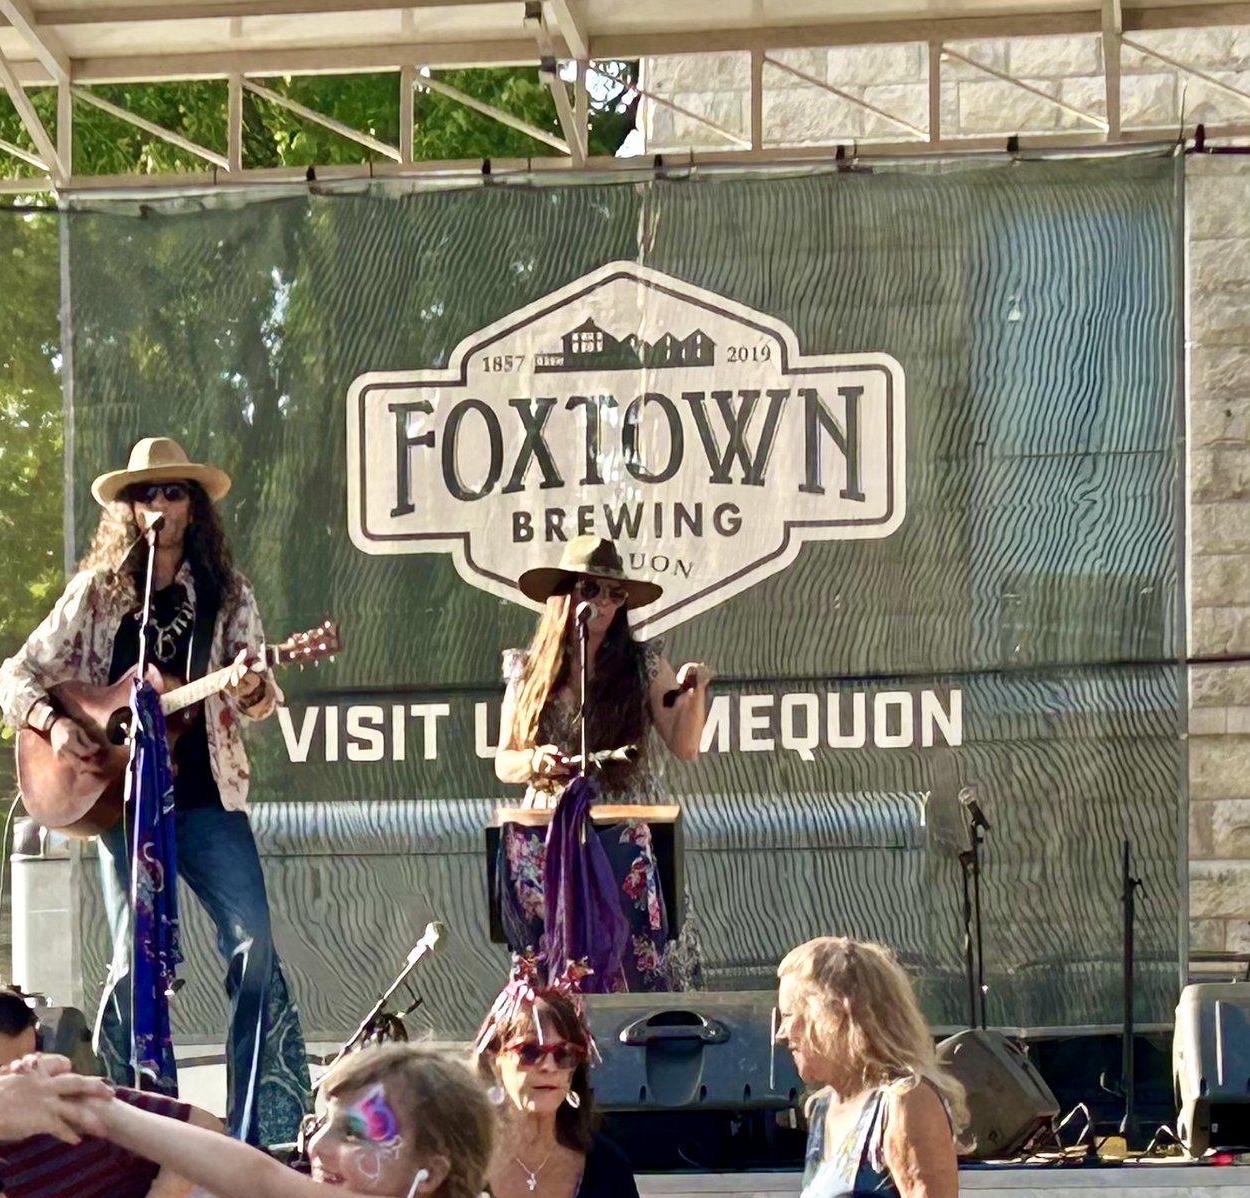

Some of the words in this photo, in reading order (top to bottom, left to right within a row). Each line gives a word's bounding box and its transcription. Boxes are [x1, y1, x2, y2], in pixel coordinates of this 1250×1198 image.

[483, 355, 525, 372] 1857
[727, 344, 773, 363] 2019
[388, 385, 866, 518] FOXTOWN
[512, 501, 743, 543] BREWING
[629, 552, 694, 579] UON
[276, 703, 450, 762] VISIT
